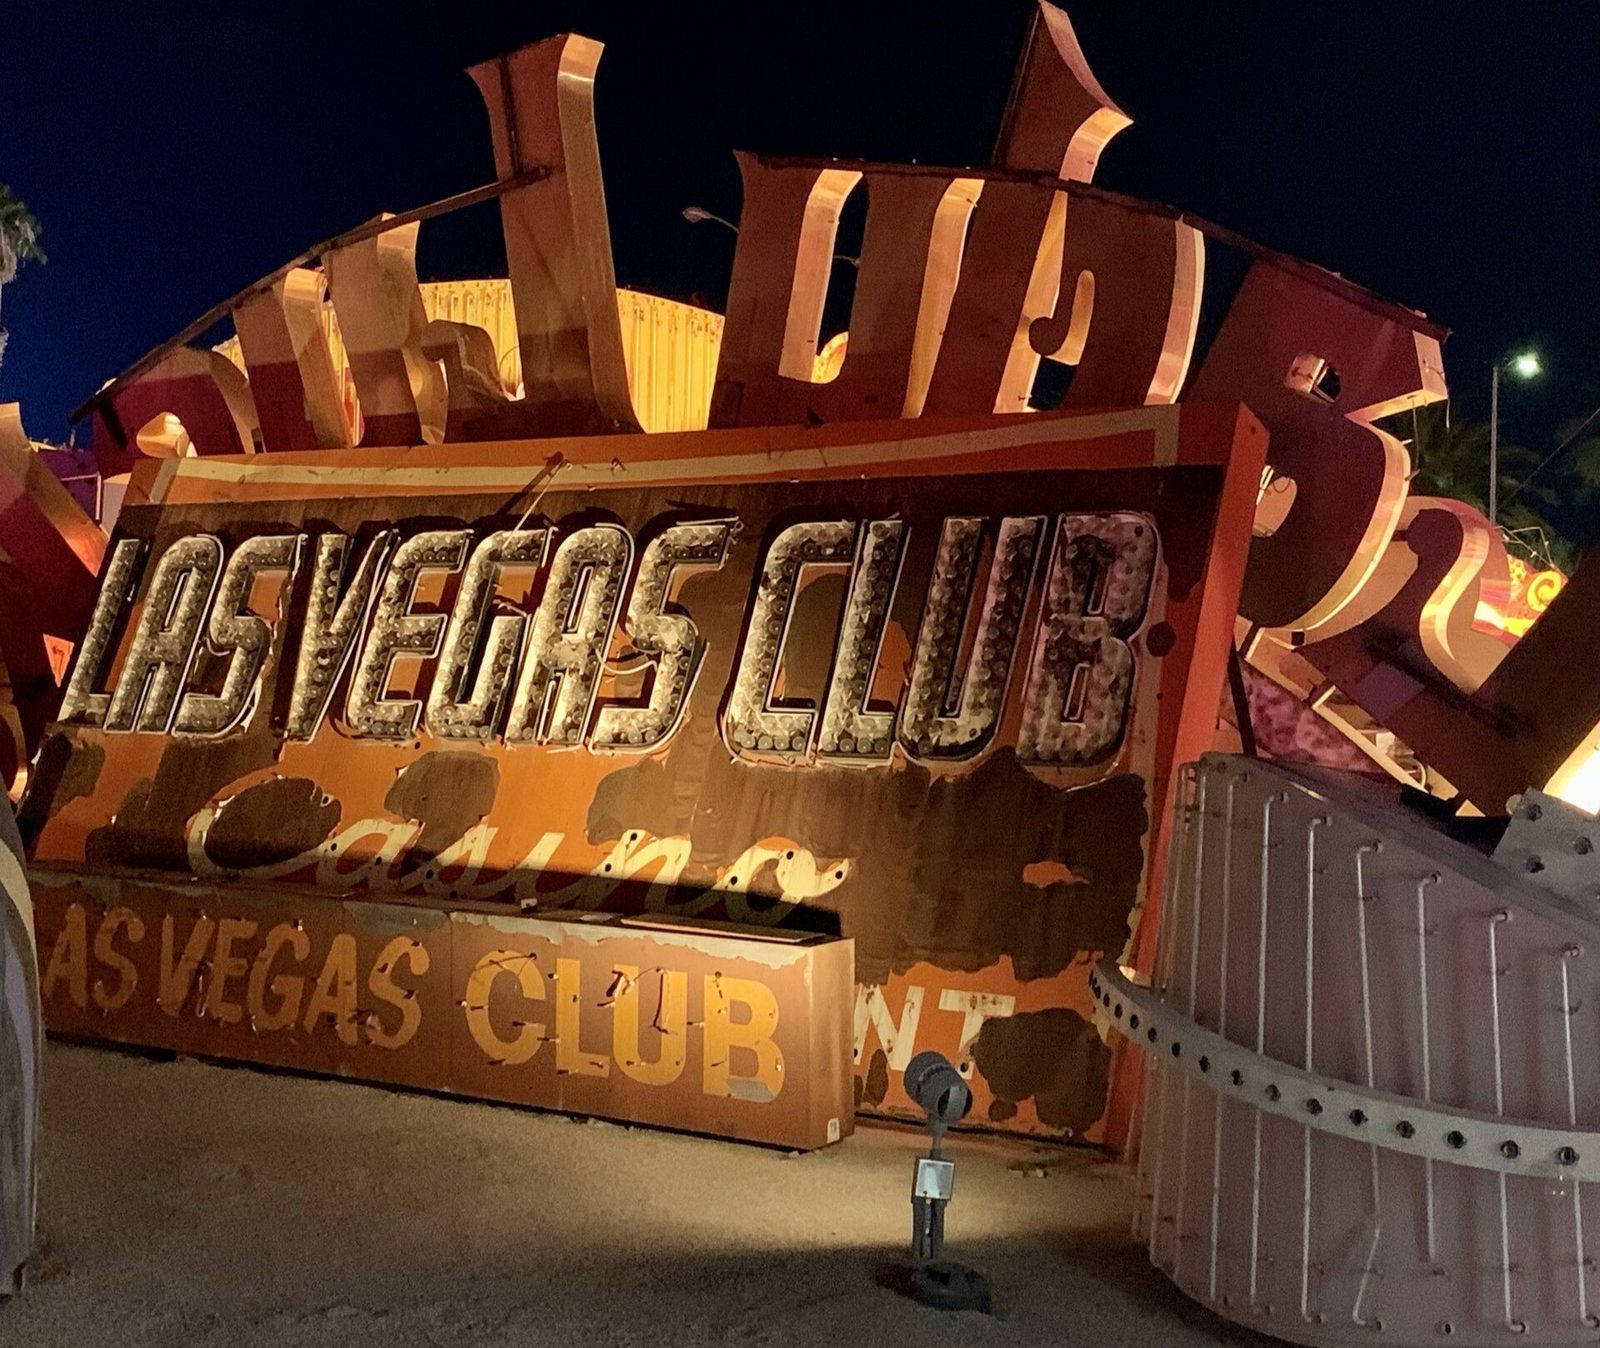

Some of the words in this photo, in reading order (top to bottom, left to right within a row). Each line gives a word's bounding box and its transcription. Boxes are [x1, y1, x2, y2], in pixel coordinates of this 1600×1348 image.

[57, 533, 307, 737] LAS
[286, 516, 742, 756] VEGAS
[718, 512, 1158, 768] CLUB
[187, 778, 849, 925] Casino
[157, 911, 430, 1050] VEGAS
[465, 949, 785, 1104] CLUB
